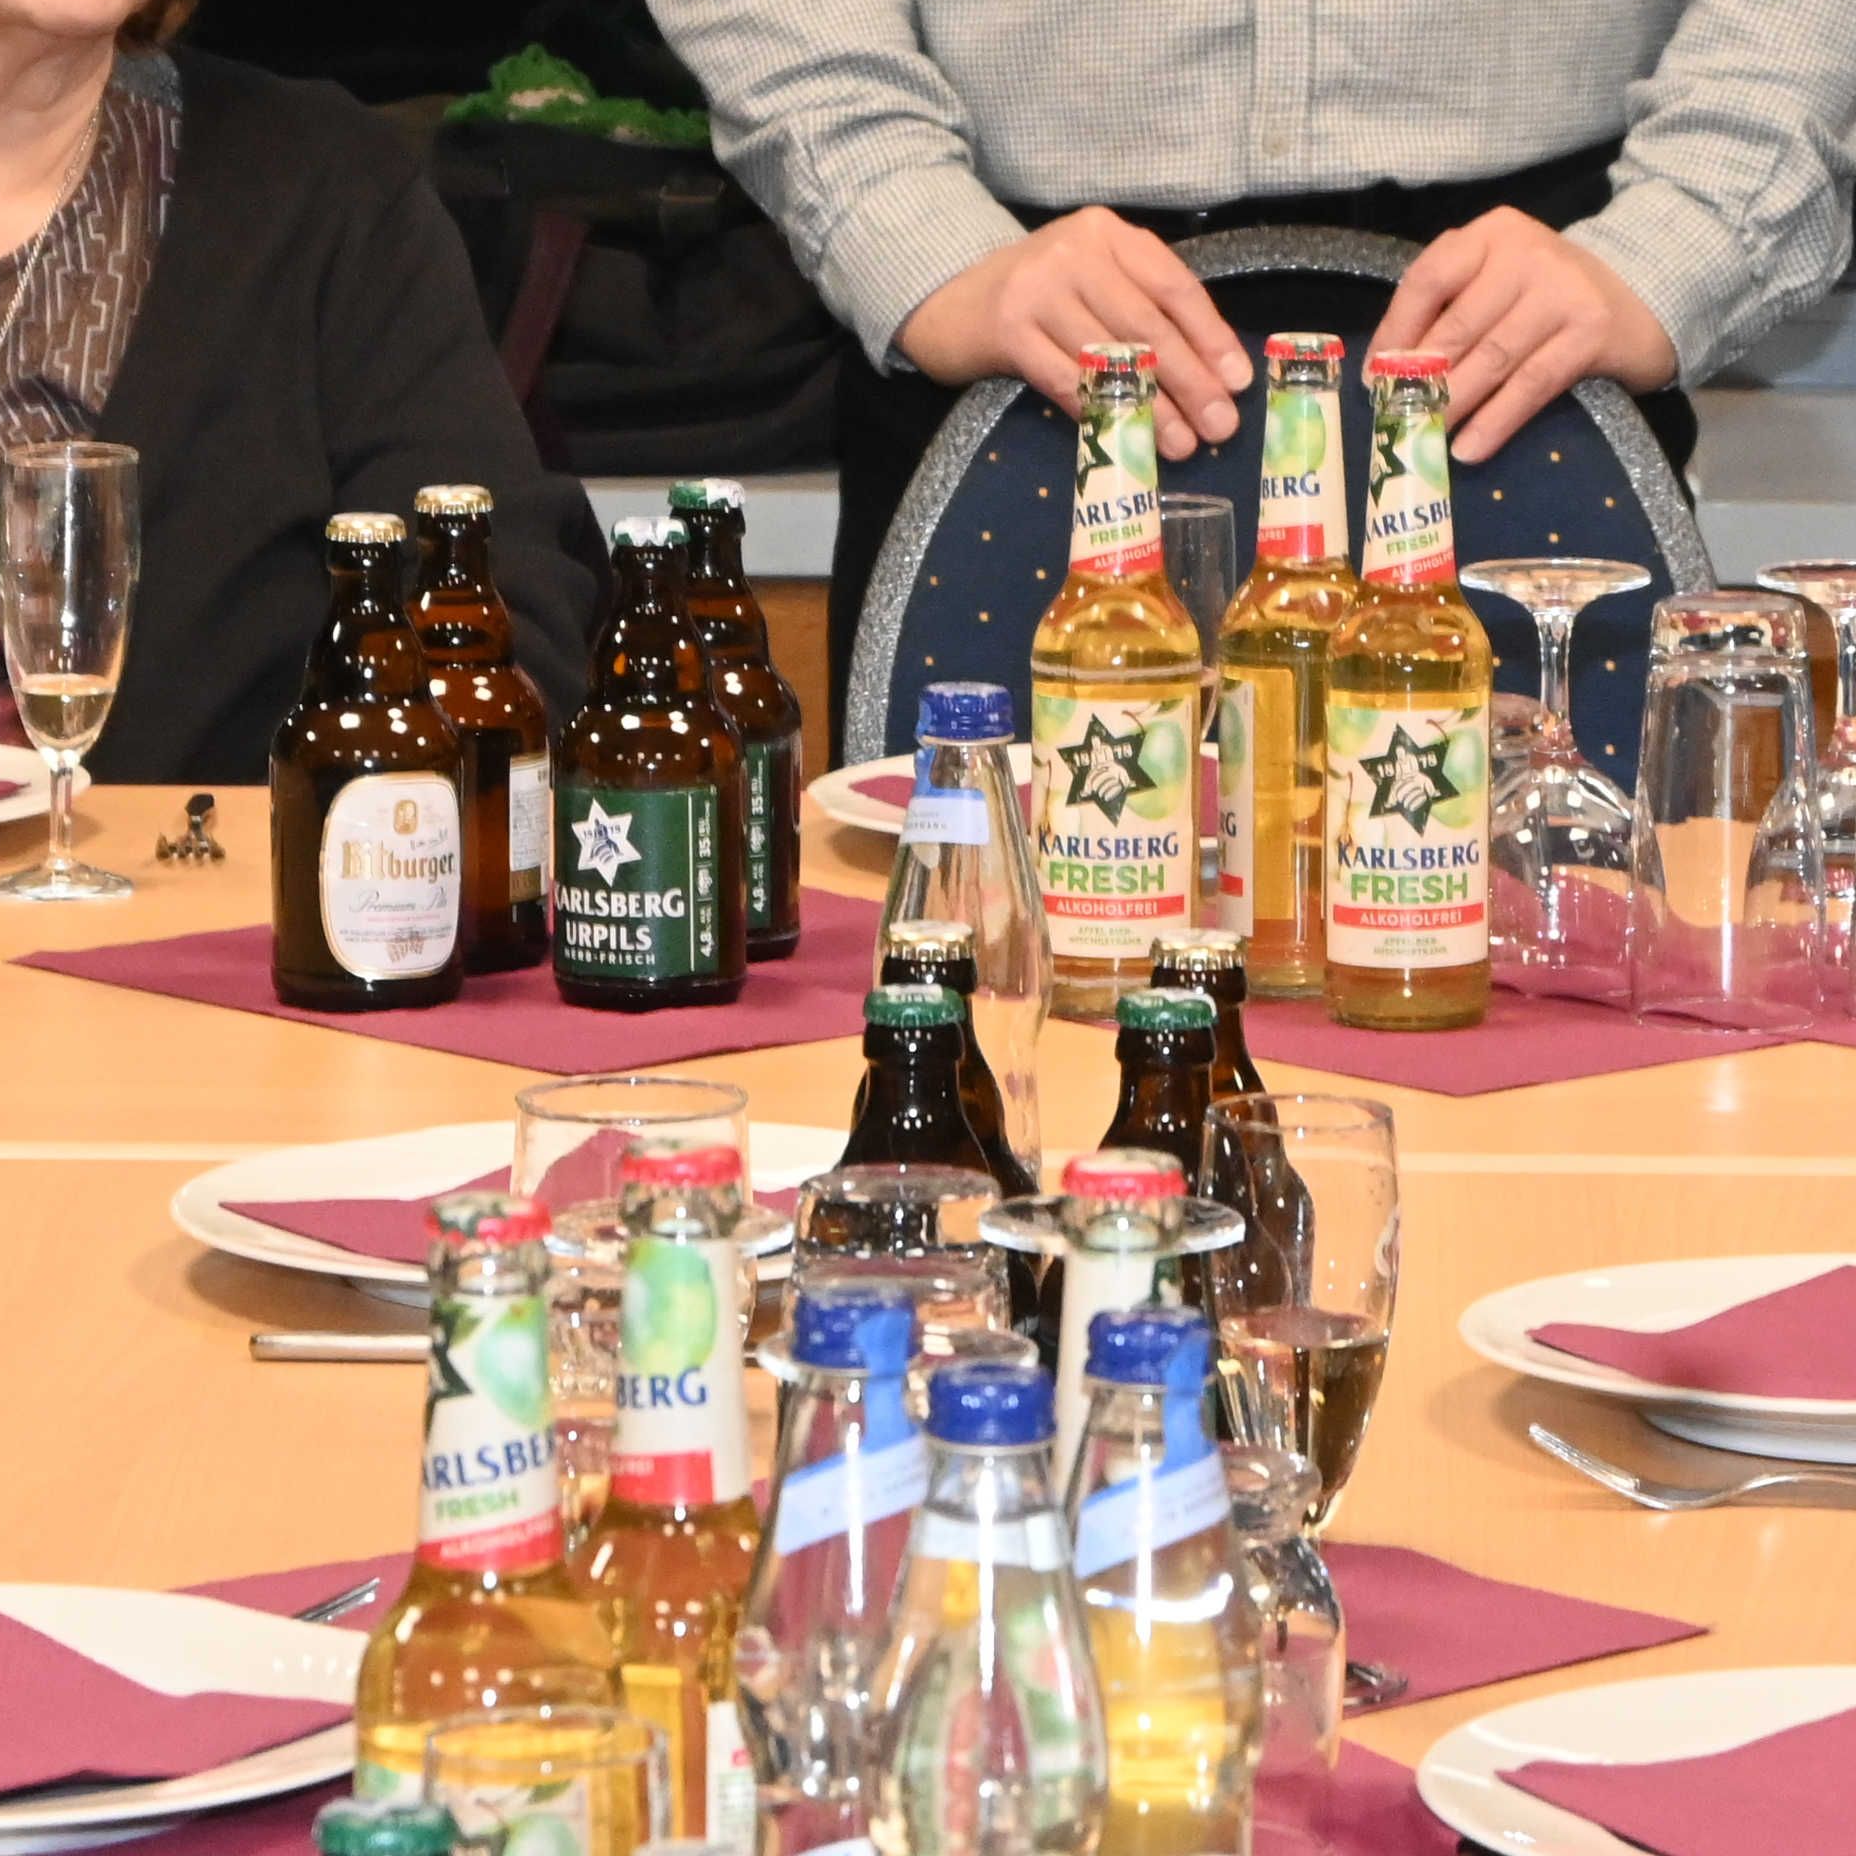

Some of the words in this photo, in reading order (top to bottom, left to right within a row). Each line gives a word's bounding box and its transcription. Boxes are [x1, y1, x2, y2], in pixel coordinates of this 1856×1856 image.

[1090, 522, 1143, 546] FRESH
[1386, 530, 1439, 556] FRESH
[1038, 827, 1180, 861] KARLSBERG
[1337, 838, 1480, 871] KARLSBERG
[342, 840, 455, 884] Bitburger
[1048, 861, 1166, 893] FRESH
[1350, 872, 1469, 904] FRESH
[1055, 899, 1159, 917] ALKOHOLFREI
[1359, 909, 1463, 927] ALKOHOLFREI
[566, 919, 653, 952] URPILS
